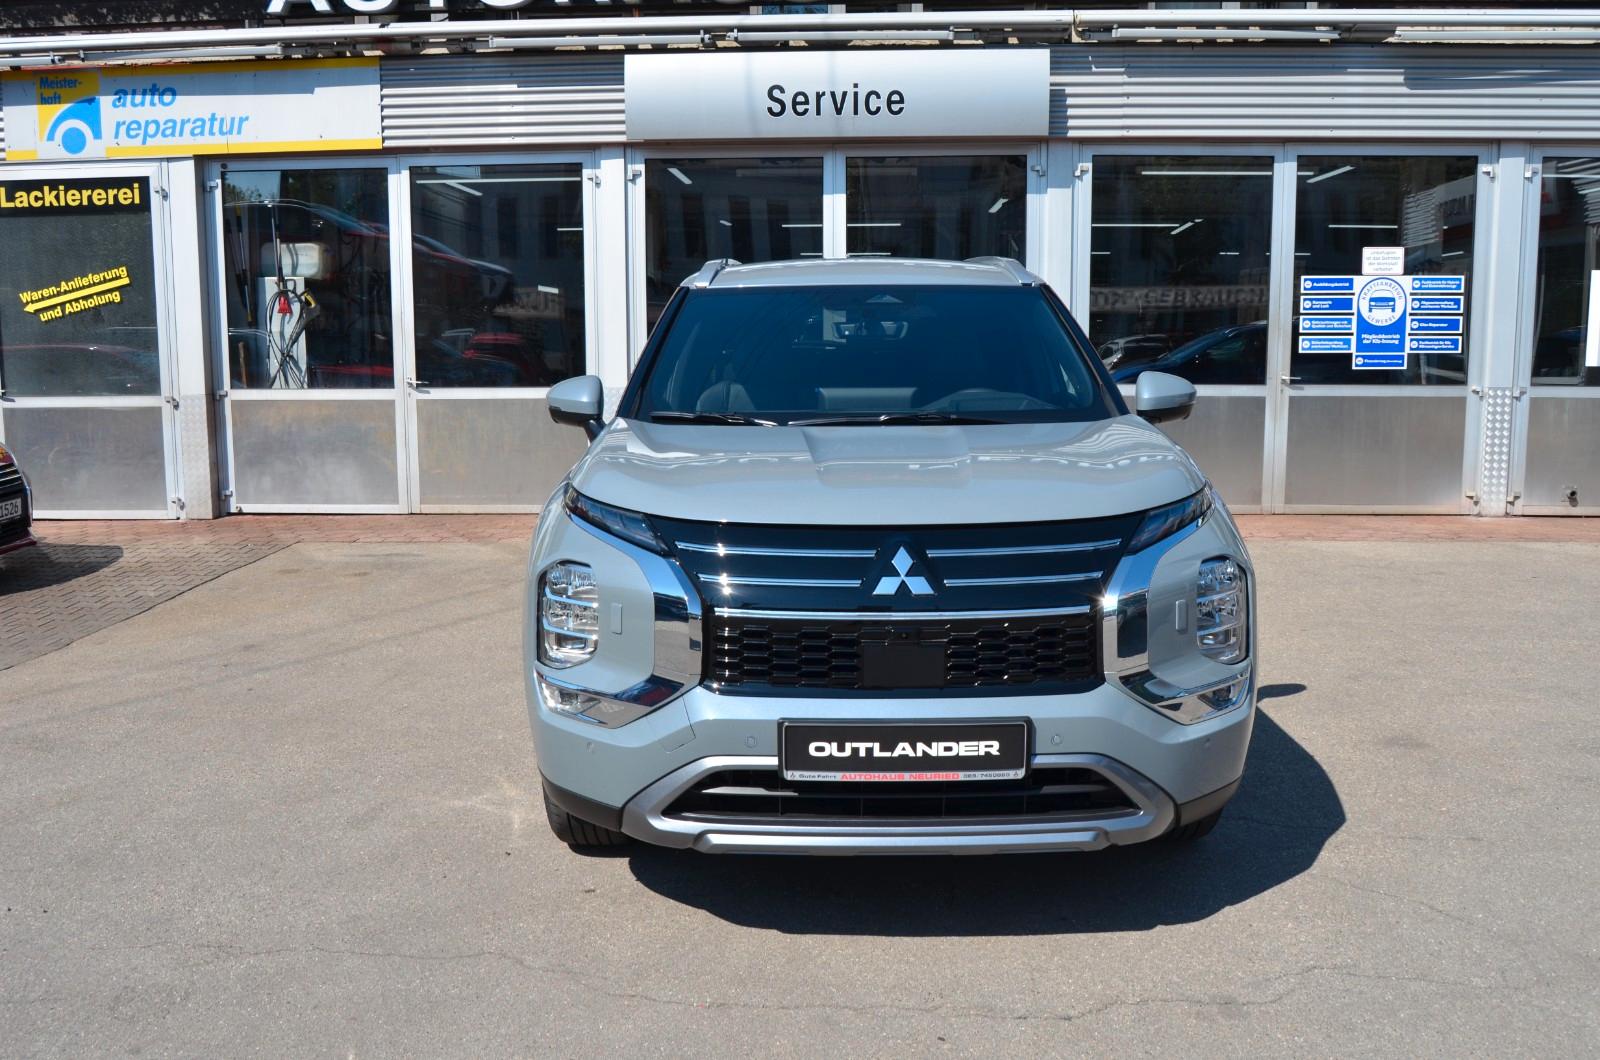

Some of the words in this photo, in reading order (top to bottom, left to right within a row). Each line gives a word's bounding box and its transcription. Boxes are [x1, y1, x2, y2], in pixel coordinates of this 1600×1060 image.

[39, 76, 83, 90] Meister-
[111, 83, 177, 109] auto
[40, 92, 62, 106] haft
[766, 82, 906, 118] Service
[113, 112, 250, 146] reparatur
[0, 183, 141, 209] Lackiererei
[19, 266, 128, 304] Waren-Anlieferung
[39, 306, 62, 322] und
[65, 291, 121, 316] Abholung
[808, 740, 1001, 757] OUTLANDER
[840, 773, 905, 781] AUTOHAUS
[908, 772, 961, 781] NEURIED
